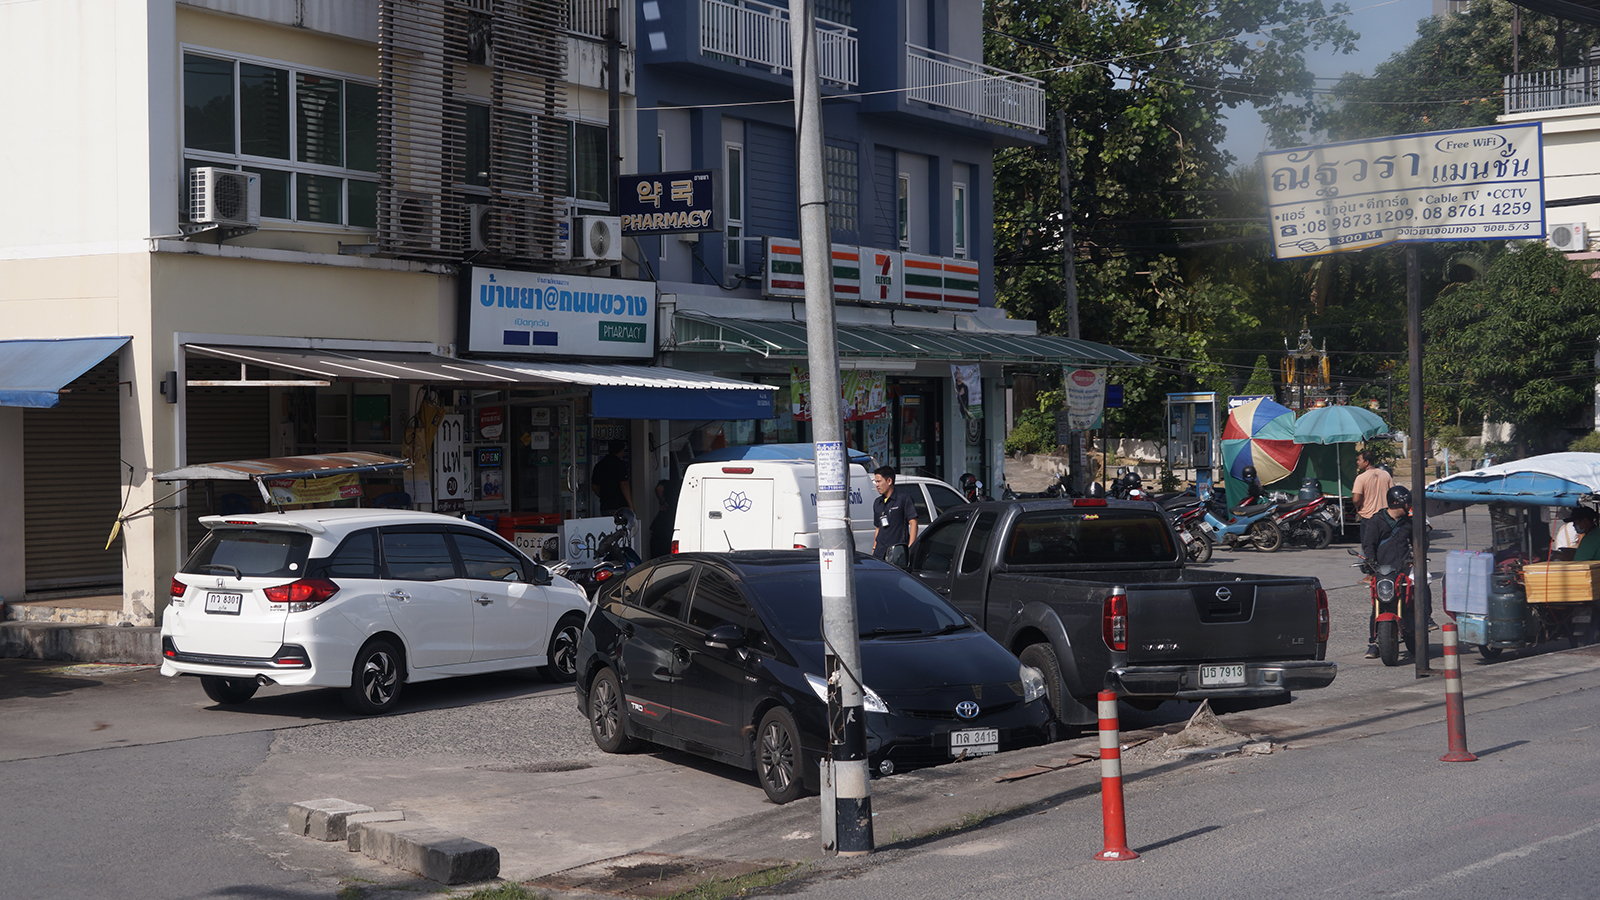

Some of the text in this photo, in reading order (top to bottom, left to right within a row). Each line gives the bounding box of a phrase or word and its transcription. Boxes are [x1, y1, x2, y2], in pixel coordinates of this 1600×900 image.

[1446, 138, 1497, 151] Free WiFi
[1271, 143, 1530, 198] ณัฐวรา แมนชั่น
[1425, 193, 1459, 205] Cable
[1463, 190, 1480, 201] TV
[1493, 188, 1528, 201] CCTV
[1422, 207, 1443, 221] 08
[1447, 204, 1486, 218] 8761
[1490, 201, 1532, 217] 4259
[621, 209, 712, 231] PHARMACY
[1337, 230, 1380, 245] 300 M.
[479, 273, 648, 317] บ้านยา@ถนนขวาง
[514, 317, 549, 328] เปิดทุกวัน
[603, 324, 641, 339] PHARMACY
[481, 452, 500, 462] OPEN
[448, 481, 457, 491] 20
[515, 536, 557, 550] Coffee
[223, 595, 240, 605] 8301
[1292, 637, 1305, 645] LE
[1220, 666, 1243, 678] 7913
[631, 702, 645, 712] TRD
[956, 730, 998, 745] กล 3415
